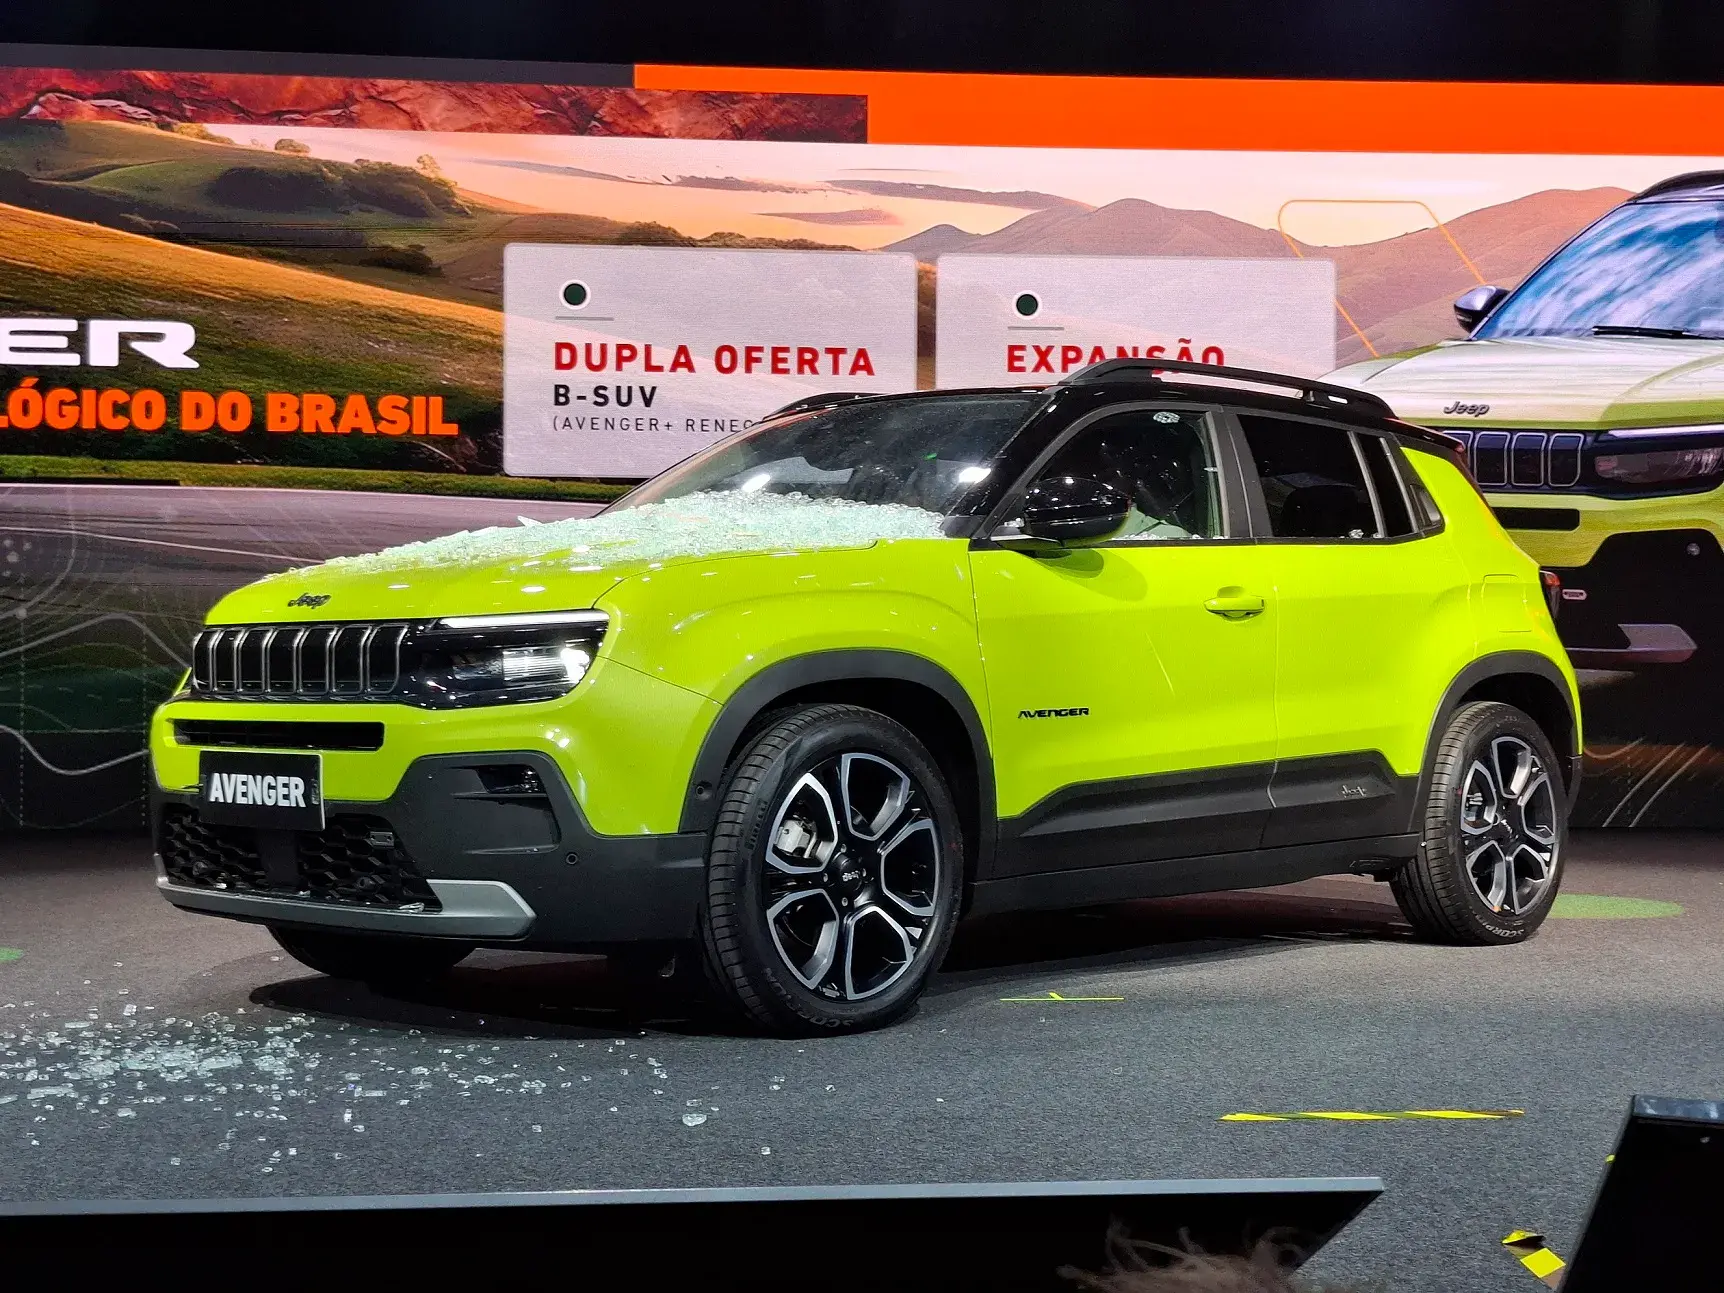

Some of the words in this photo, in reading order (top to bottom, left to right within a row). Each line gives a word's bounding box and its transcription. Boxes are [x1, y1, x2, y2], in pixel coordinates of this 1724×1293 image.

[554, 341, 696, 373] DUPLA
[714, 344, 875, 376] OFERTA
[553, 384, 657, 408] B-SUV
[181, 390, 252, 432] DO
[266, 391, 459, 436] BRASIL
[1443, 401, 1490, 418] Jeep
[287, 592, 332, 610] Jeep
[1017, 707, 1090, 719] AVENGER
[208, 772, 307, 808] AVENGER
